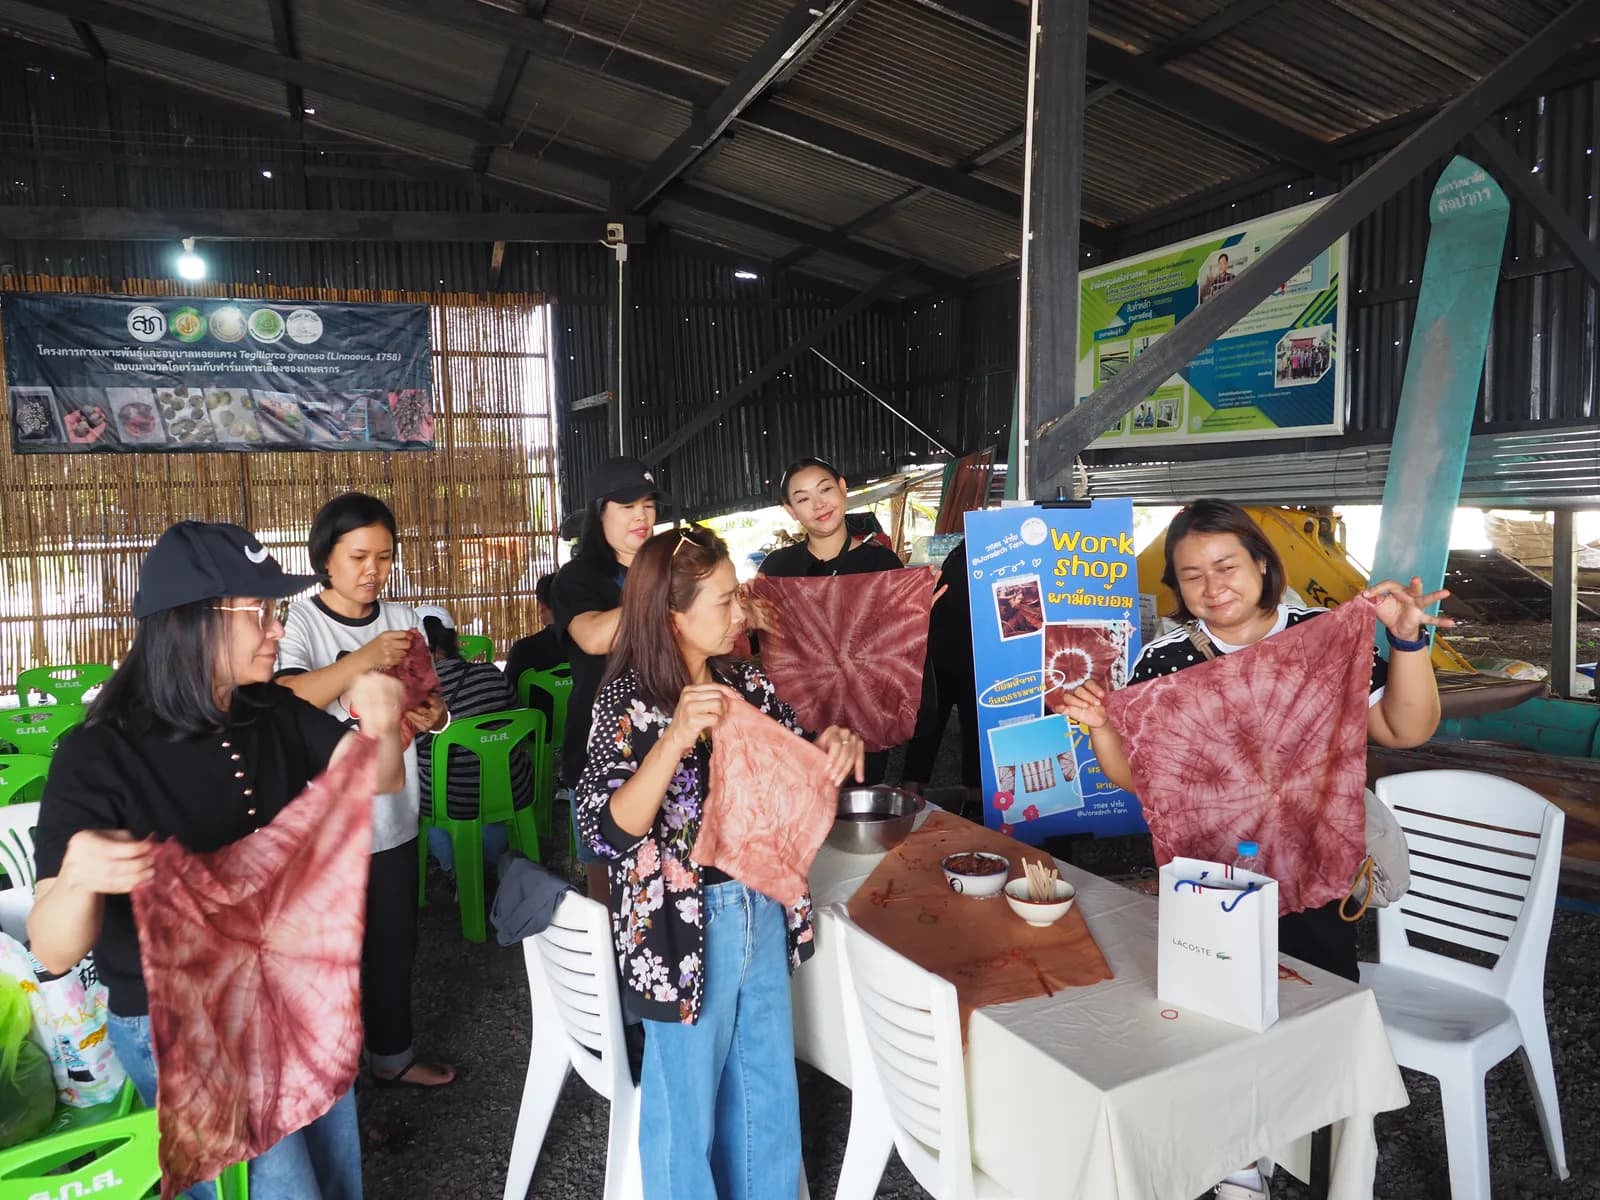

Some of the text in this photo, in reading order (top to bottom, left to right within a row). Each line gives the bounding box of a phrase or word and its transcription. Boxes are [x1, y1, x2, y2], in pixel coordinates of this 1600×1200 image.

[1438, 187, 1492, 213] ศิลปากร
[240, 350, 286, 362] Tegillarca
[287, 352, 325, 362] granosa
[327, 352, 374, 362] (Linnaeus,
[376, 352, 401, 362] 1758)
[1050, 527, 1135, 556] Work
[1048, 580, 1134, 609] ผ้ามัดย้อม
[16, 726, 49, 735] ธ.ก.ส.
[480, 732, 510, 743] ธ.ก.ส.
[1172, 937, 1212, 957] LACOSTE
